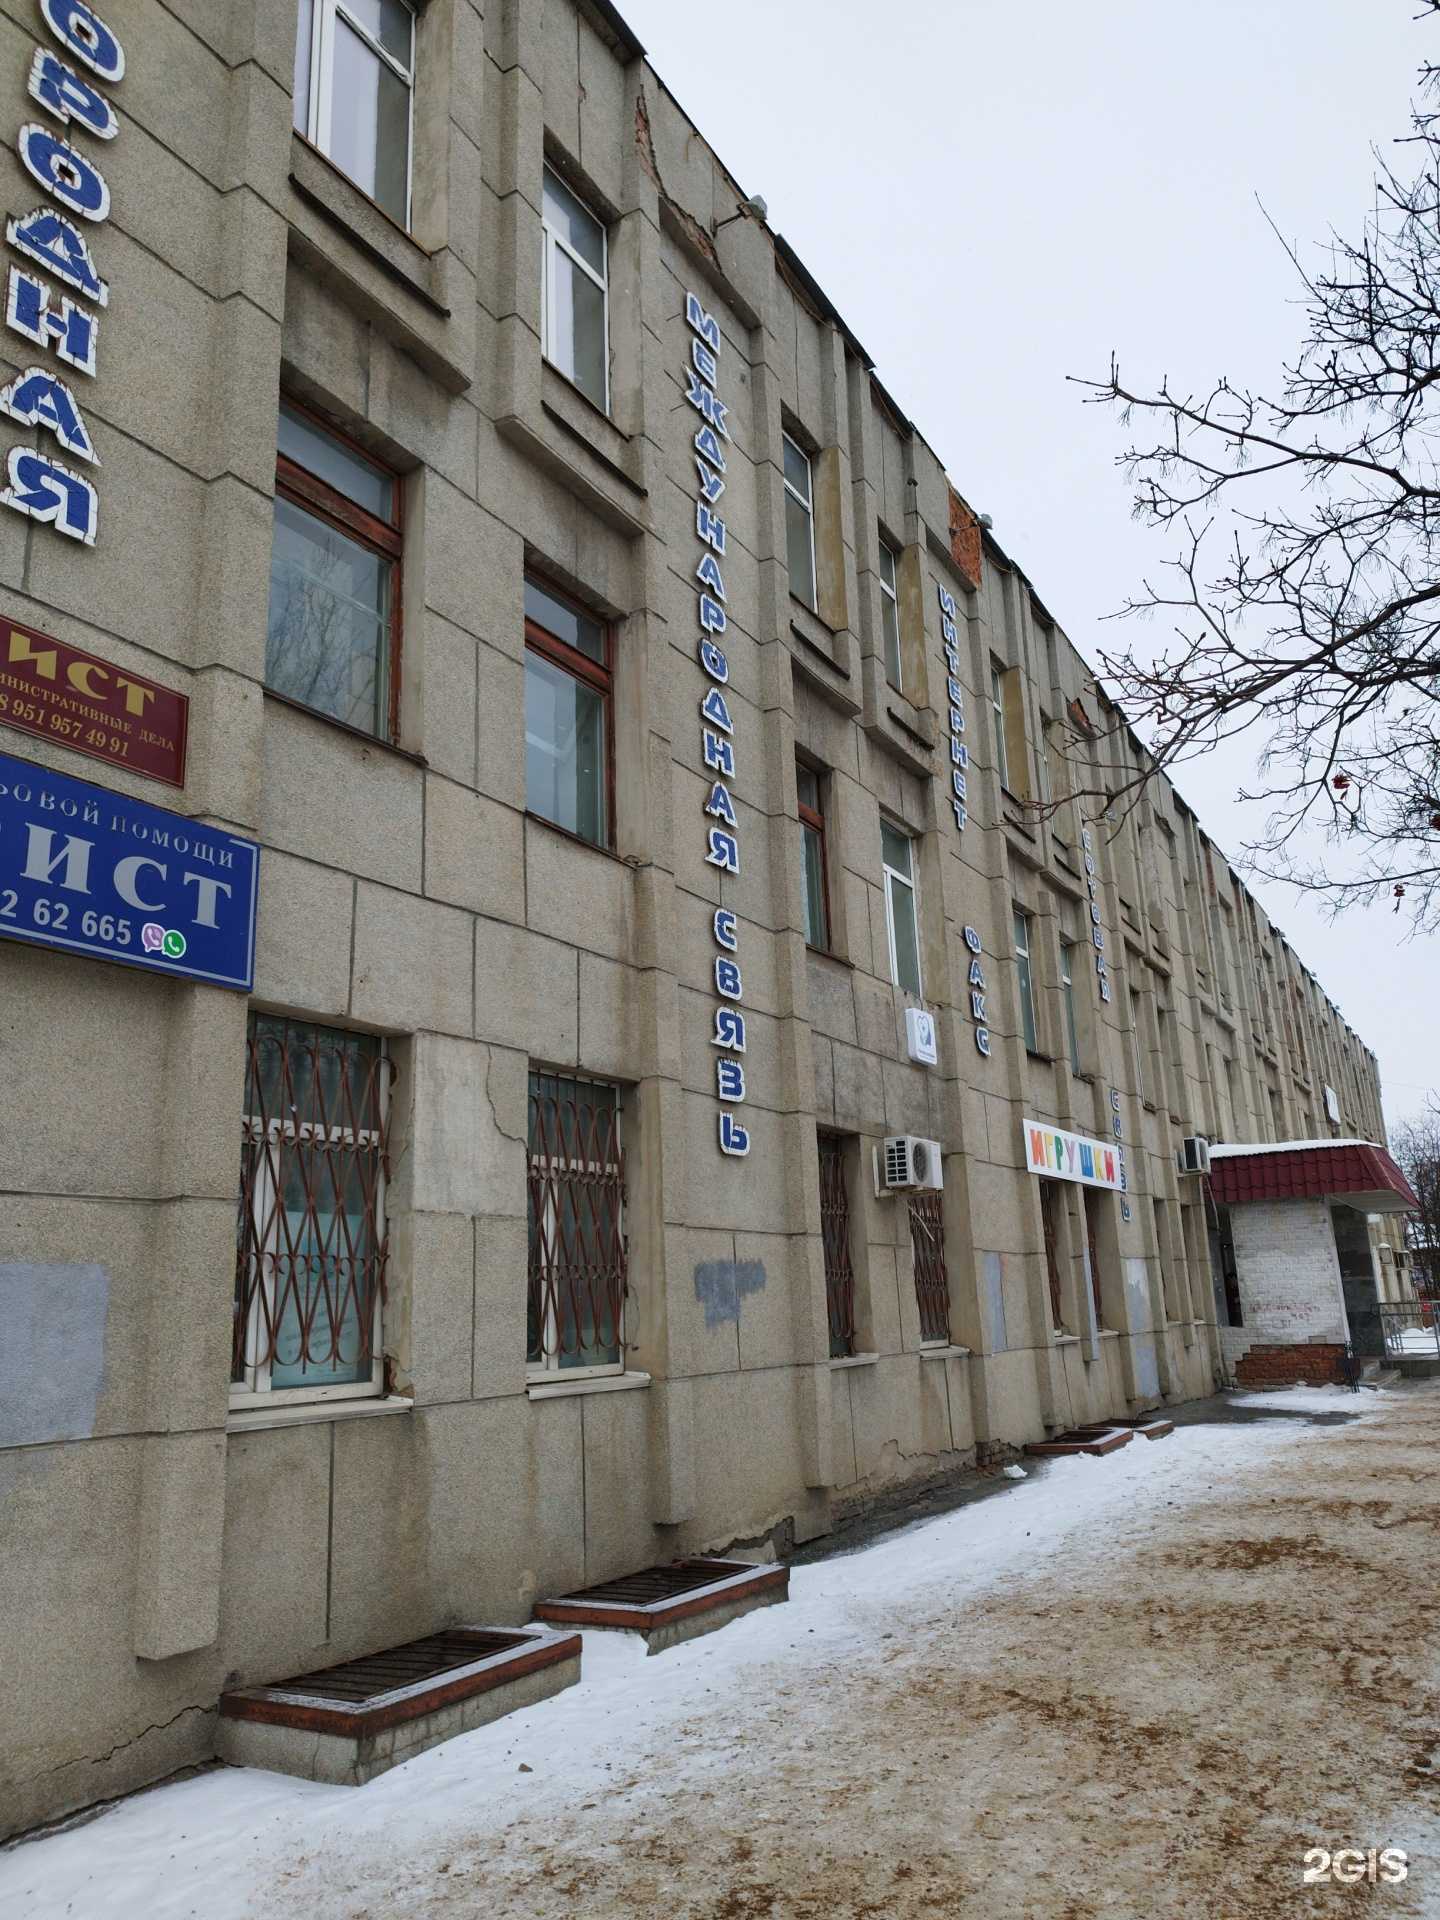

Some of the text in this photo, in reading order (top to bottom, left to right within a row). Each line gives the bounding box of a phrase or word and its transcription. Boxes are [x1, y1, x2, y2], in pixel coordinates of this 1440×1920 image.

[8, 630, 155, 718] ИСТ
[12, 699, 46, 726] 951
[50, 714, 83, 739] 957
[85, 729, 106, 748] 49
[110, 737, 129, 758] 91
[682, 292, 750, 1157] МЕЖДУНАРОДНАЯ СВЯЗЬ
[938, 583, 968, 831] ИНТЕРНЕТ
[139, 729, 175, 752] ДЕЛА
[111, 815, 233, 868] ПОМОЩИ
[0, 822, 232, 929] ИСТ
[33, 898, 70, 931] 62
[81, 910, 132, 945] 665
[1029, 1128, 1115, 1184] ИГРУШКИ
